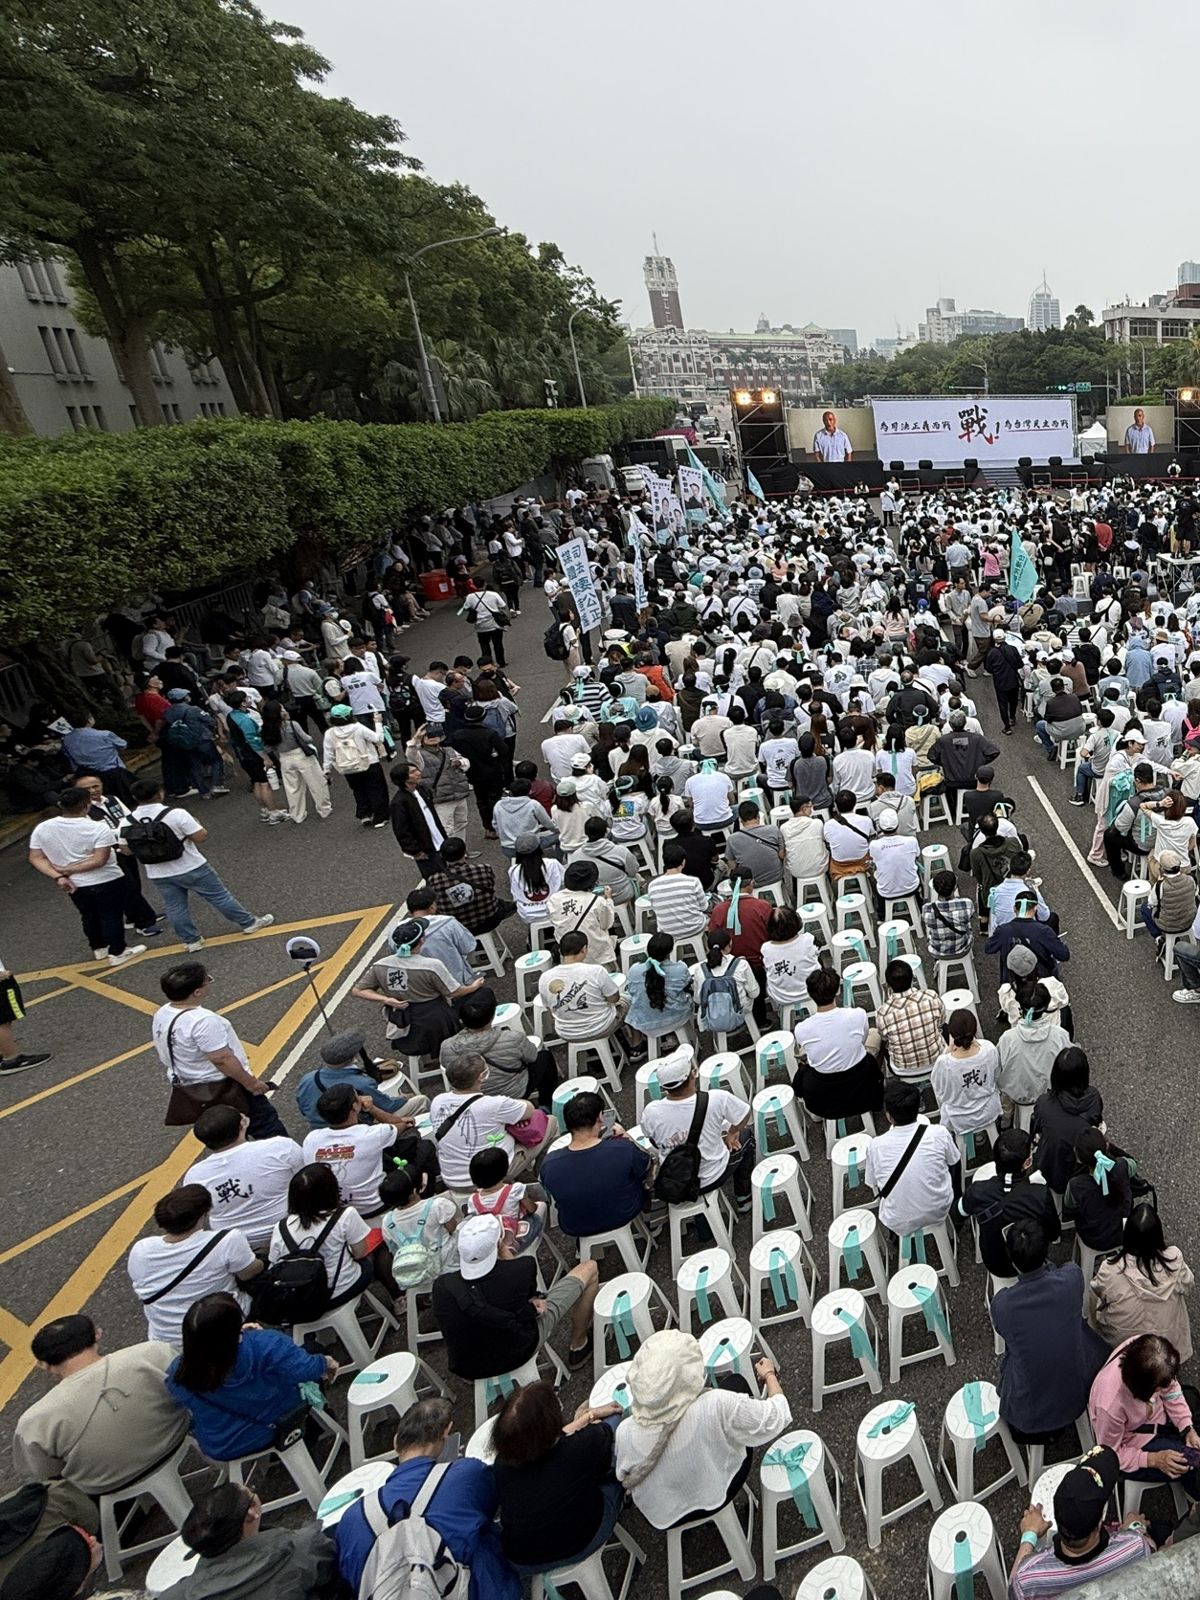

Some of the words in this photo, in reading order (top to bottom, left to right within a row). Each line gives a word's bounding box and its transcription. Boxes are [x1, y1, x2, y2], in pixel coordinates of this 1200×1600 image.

[880, 421, 952, 432] 為司法正義而戰
[958, 404, 1000, 445] 戰!
[1004, 419, 1069, 430] 為台灣民主而戰
[572, 544, 601, 622] 司法要公正
[561, 899, 583, 916] 戰!
[774, 960, 796, 976] 戰!
[962, 1069, 987, 1088] 戰!
[215, 1178, 254, 1203] 戰!
